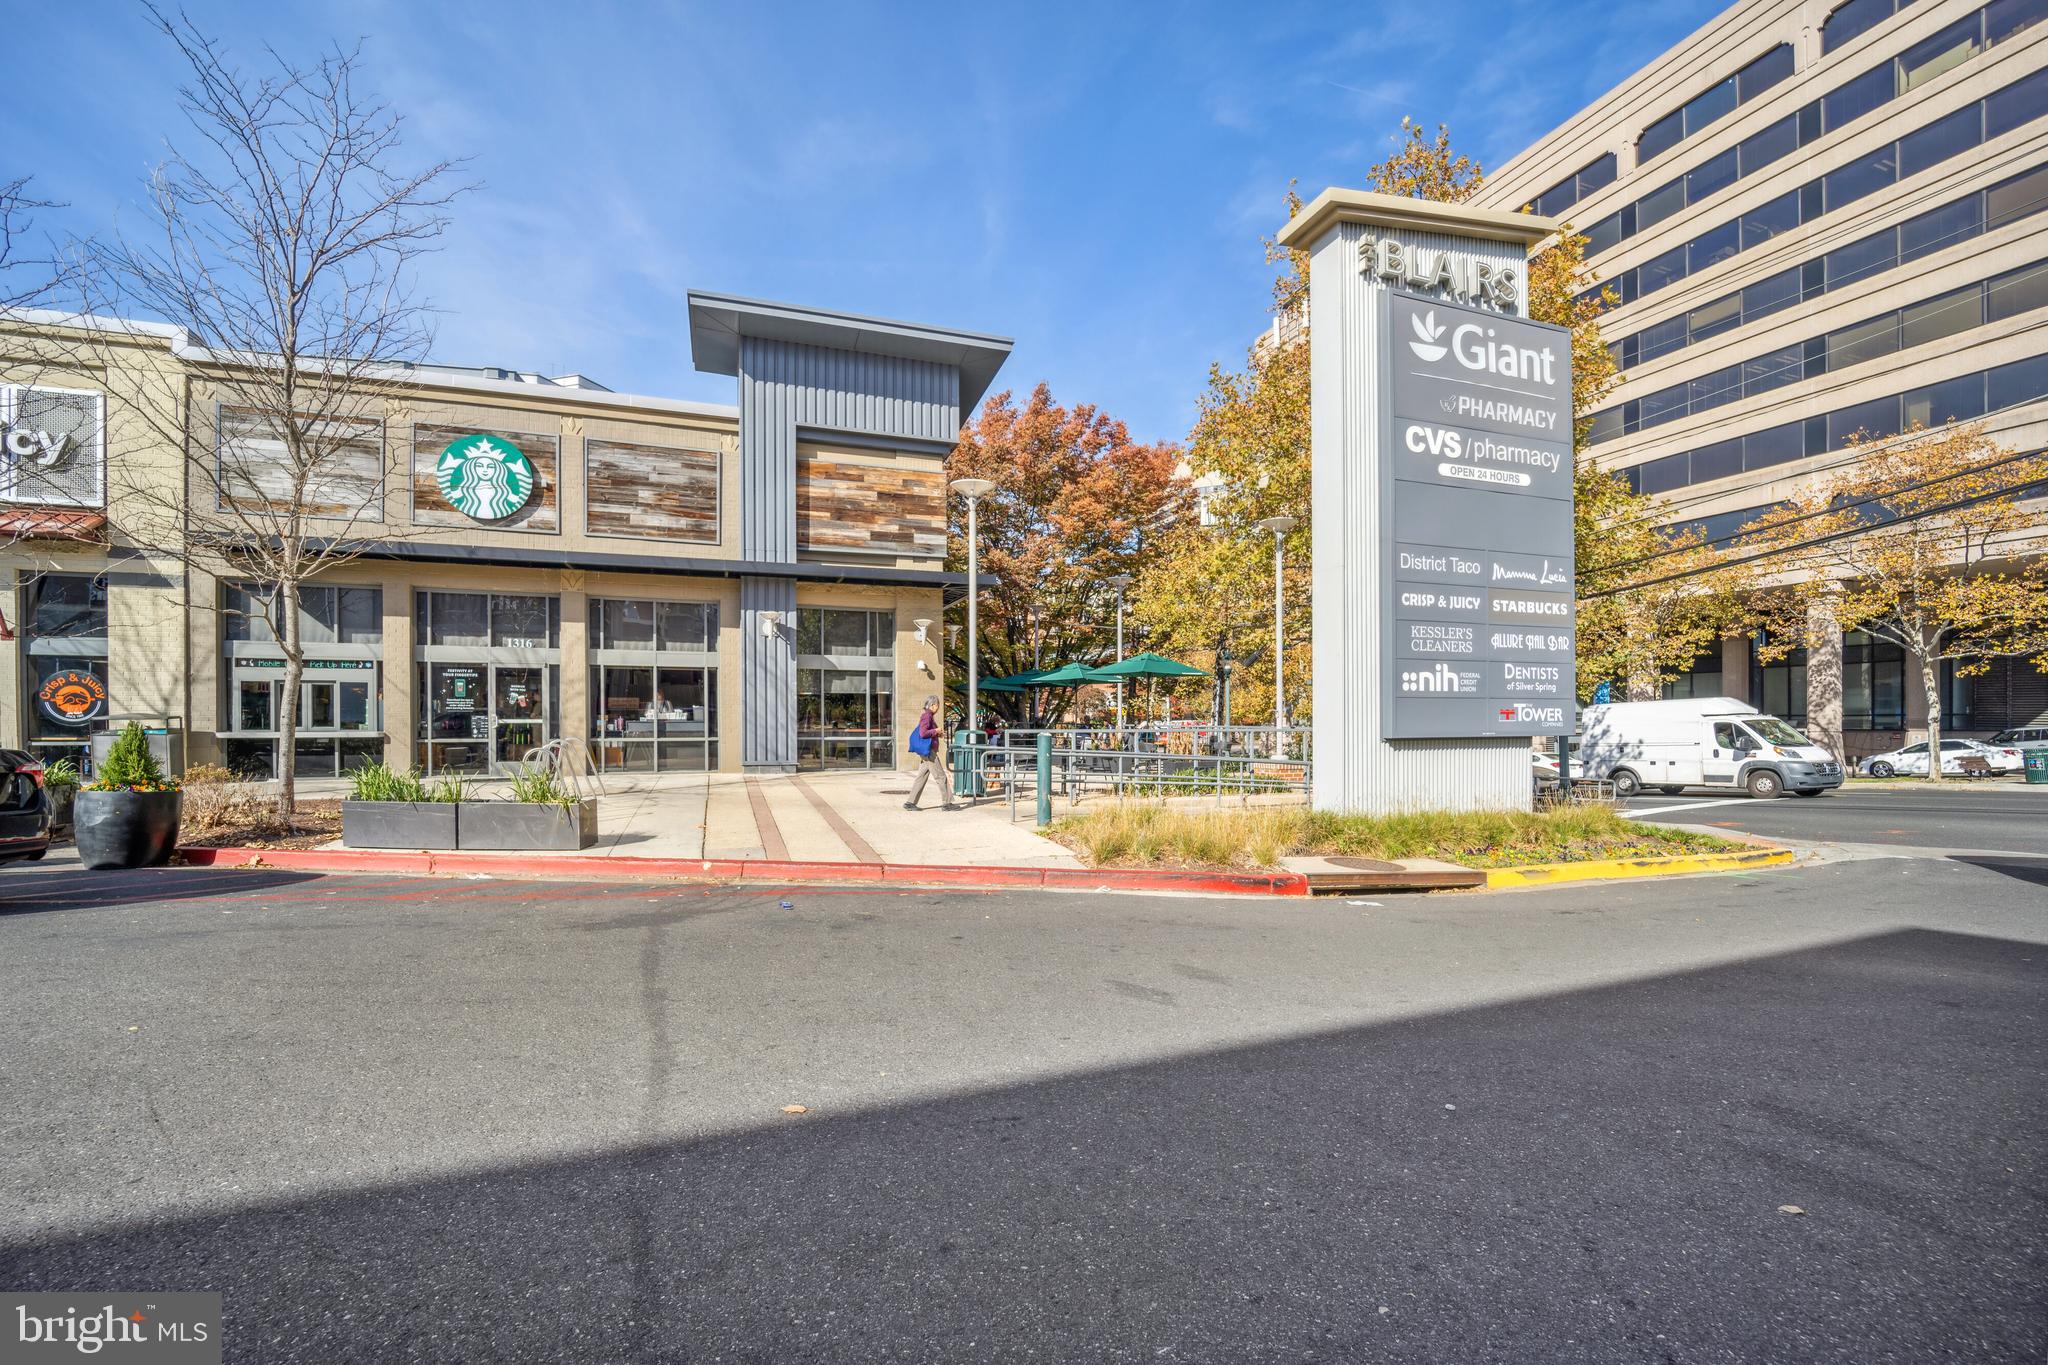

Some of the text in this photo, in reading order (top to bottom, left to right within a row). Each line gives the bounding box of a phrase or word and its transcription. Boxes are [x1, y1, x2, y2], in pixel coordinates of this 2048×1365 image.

[1379, 239, 1518, 304] BLAIRS
[1452, 323, 1556, 385] Giant
[1458, 396, 1556, 430] PHARMACY
[1405, 425, 1462, 458] CVS
[1450, 466, 1520, 485] OPEN 24 HOURS
[1400, 553, 1480, 575] District Taco
[1492, 559, 1567, 584] Mamma Lucia
[1402, 592, 1481, 610] CRISP & JUICY
[1492, 599, 1568, 616] STARBUCKS
[1411, 625, 1473, 640] KESSLER'S
[1490, 633, 1570, 651] ALLURE NAIL BAR
[507, 638, 532, 648] 1316
[1411, 639, 1473, 653] CLEANERS
[327, 661, 338, 669] Up
[341, 661, 357, 669] Here
[1504, 663, 1559, 680] DENTISTS
[39, 673, 105, 700] Crisp & Juicy
[1419, 663, 1459, 692] nih
[1507, 682, 1556, 692] of Silver Spring
[1513, 703, 1564, 722] TOWER
